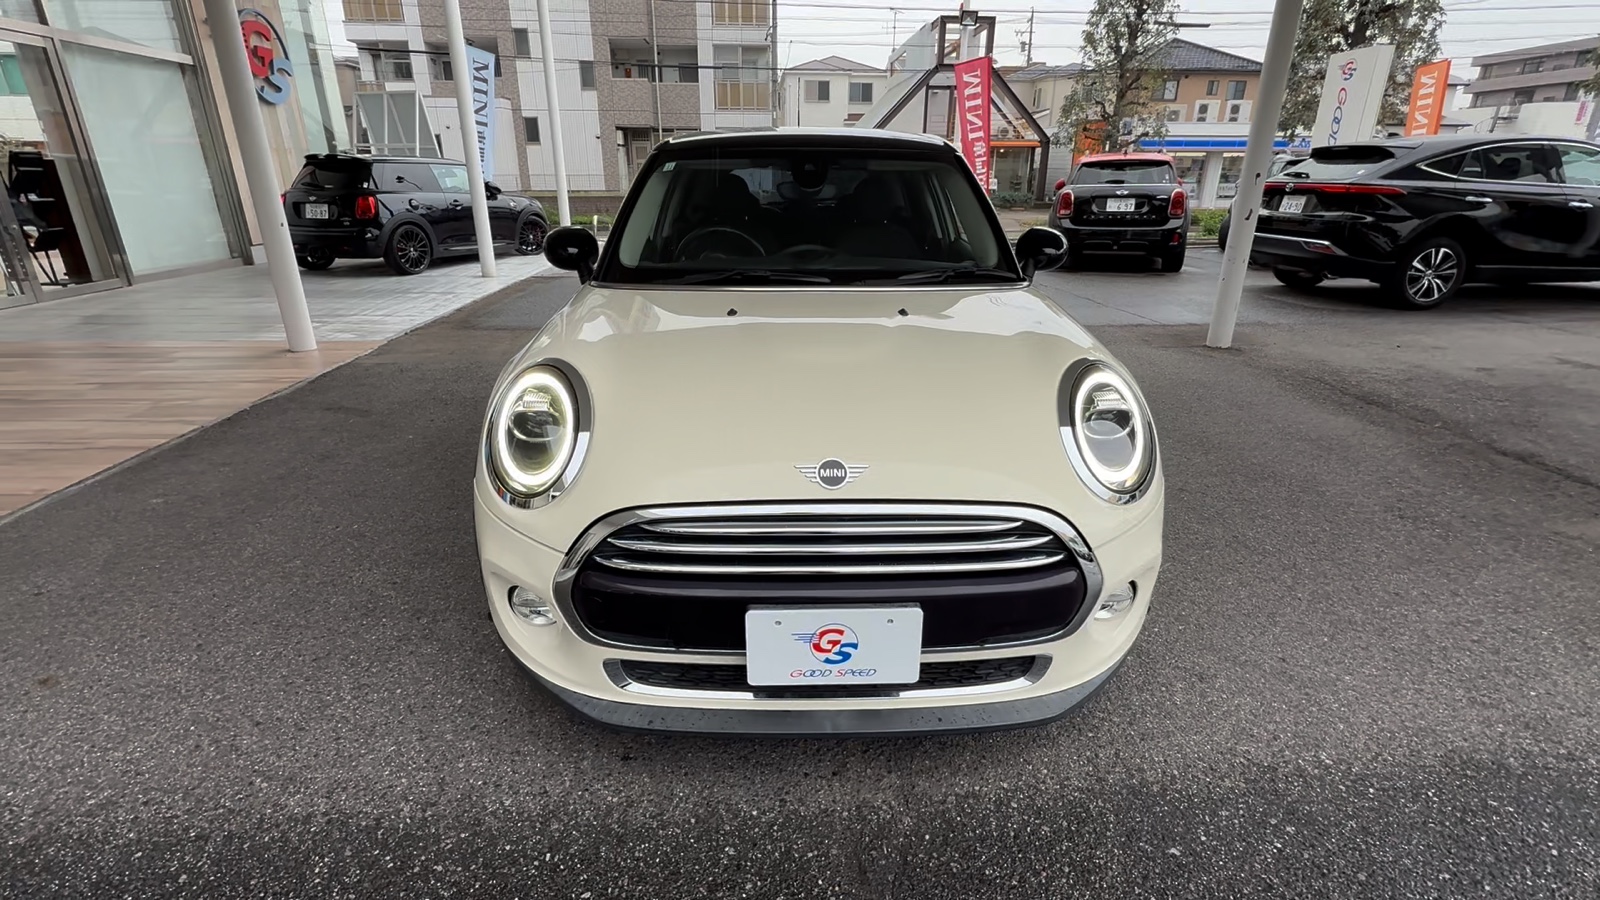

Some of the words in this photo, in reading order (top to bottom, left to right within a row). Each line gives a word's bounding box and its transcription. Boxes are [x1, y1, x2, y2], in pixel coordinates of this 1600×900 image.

[1328, 87, 1347, 146] GOOD
[820, 468, 845, 478] MINI
[790, 669, 832, 678] GOOD
[835, 668, 877, 677] SPEED
